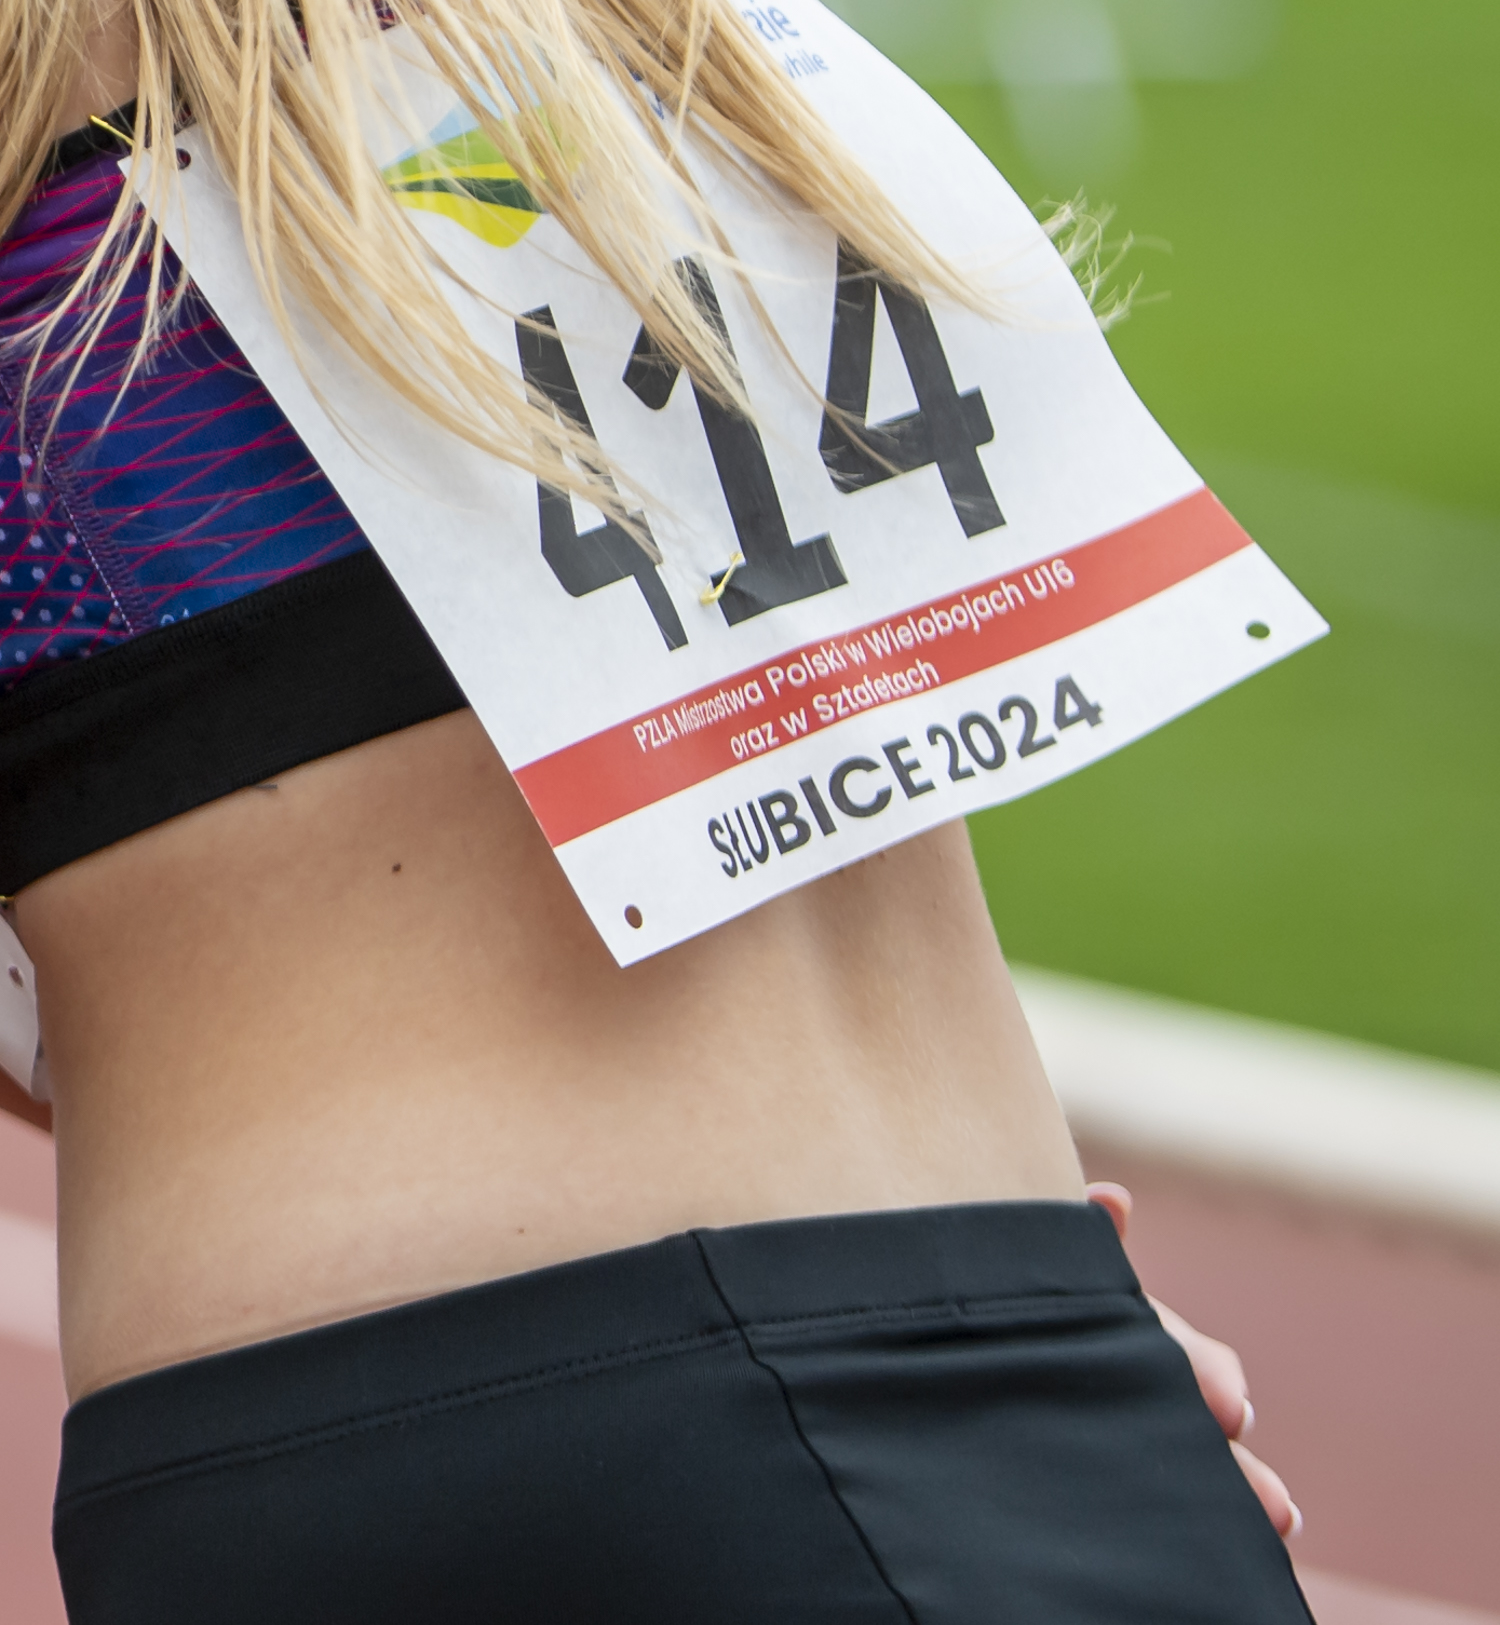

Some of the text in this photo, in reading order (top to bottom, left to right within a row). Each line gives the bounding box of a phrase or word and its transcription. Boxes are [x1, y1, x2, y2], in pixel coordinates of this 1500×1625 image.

[783, 48, 830, 79] hile
[514, 232, 1007, 652] 414
[632, 557, 1077, 754] PZLA Mistrzostwa Polski w Wielobojach U16
[729, 658, 941, 761] oraz w Sztafetach
[706, 673, 1104, 879] SŁUBICE 2024
